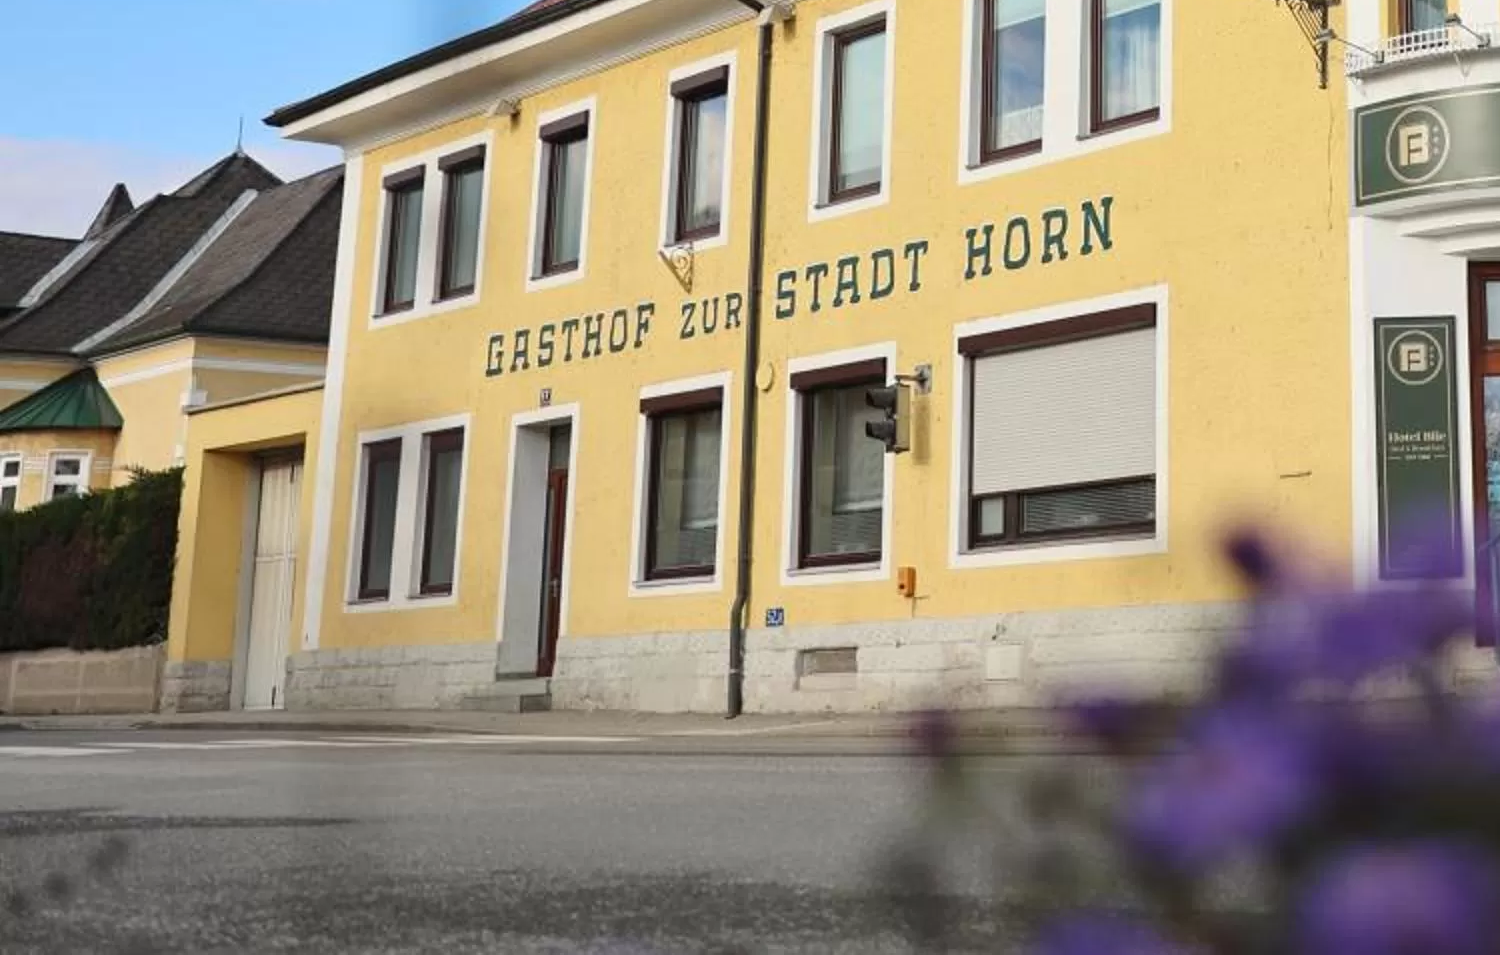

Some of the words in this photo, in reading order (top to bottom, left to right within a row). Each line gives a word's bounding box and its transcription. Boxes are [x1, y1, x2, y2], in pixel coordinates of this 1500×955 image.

[485, 303, 655, 378] GASTHOF
[680, 292, 742, 339] ZUR
[776, 241, 928, 320] STADT
[964, 197, 1114, 280] HORN
